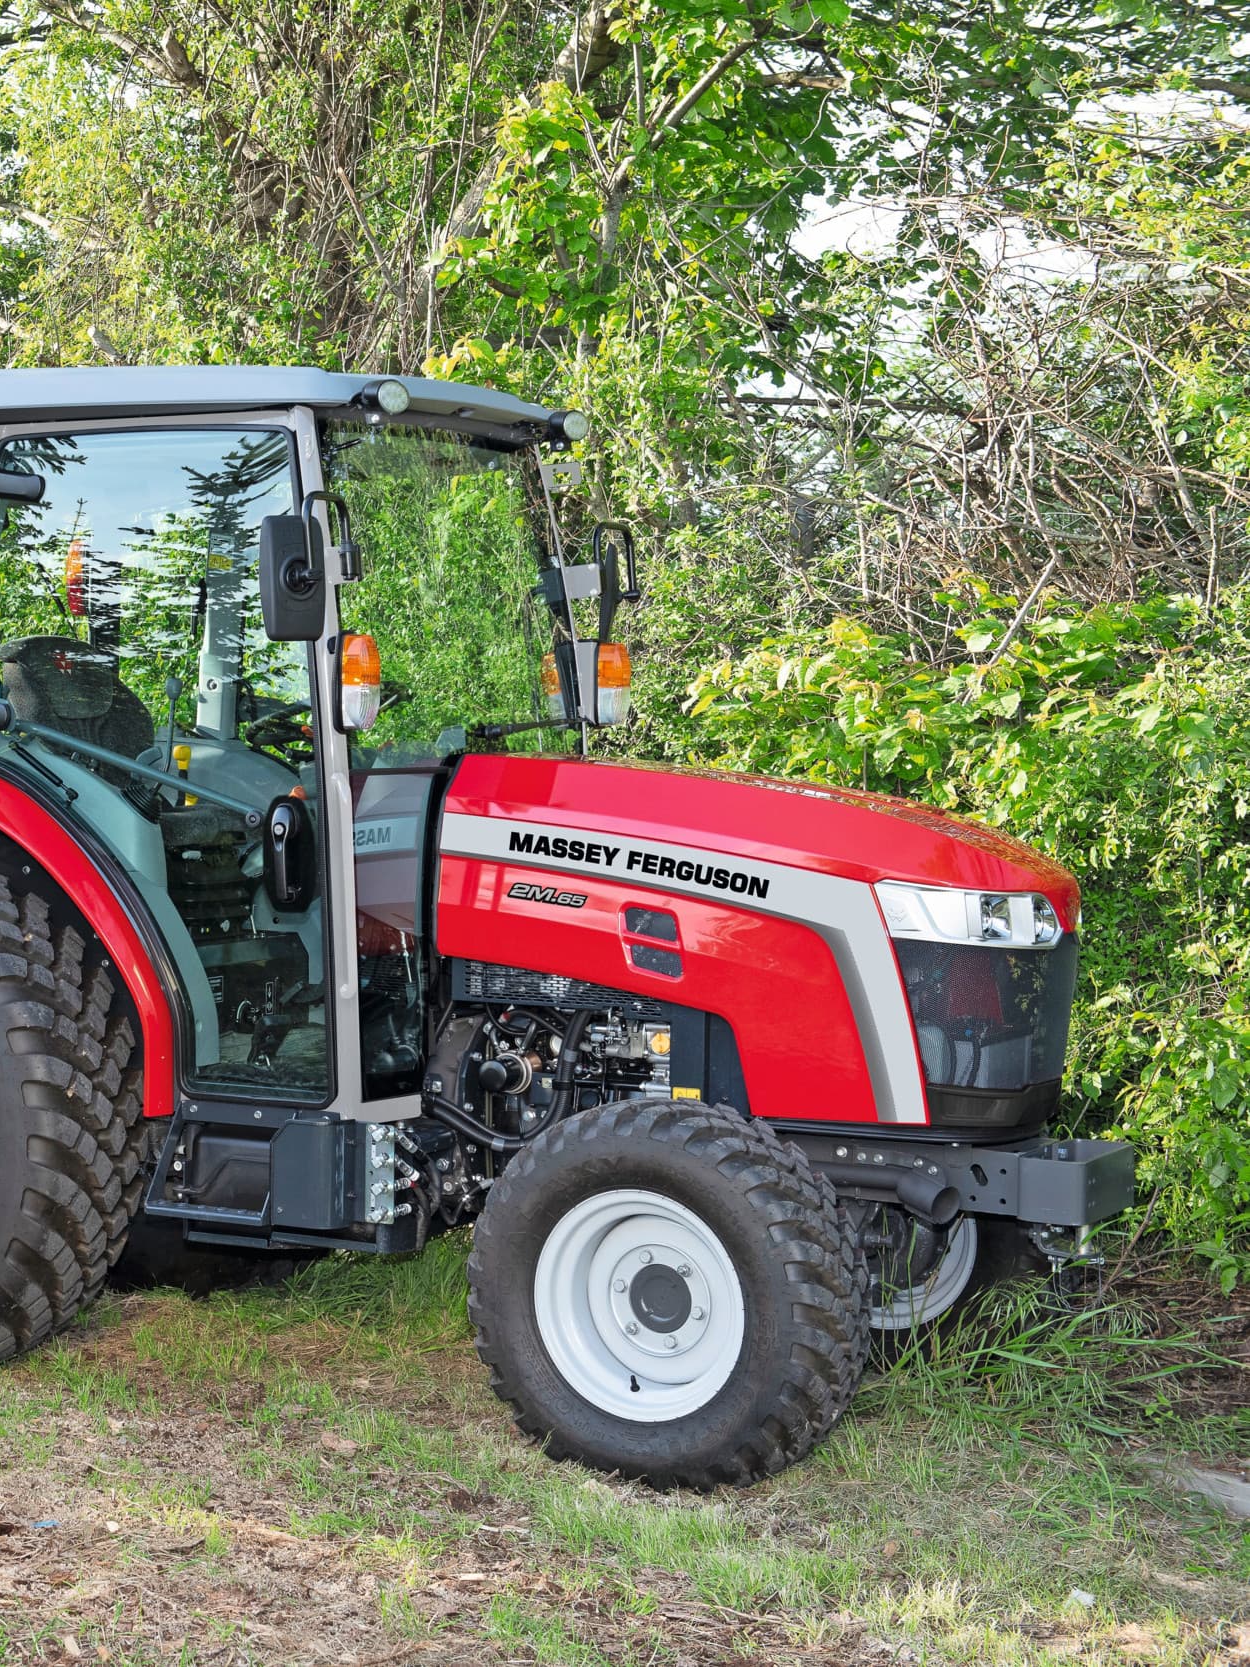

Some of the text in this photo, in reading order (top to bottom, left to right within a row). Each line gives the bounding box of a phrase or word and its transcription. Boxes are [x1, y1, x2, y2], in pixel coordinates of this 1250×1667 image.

[509, 831, 770, 899] MASSEY FERGUSON
[508, 883, 588, 907] 2M.65
